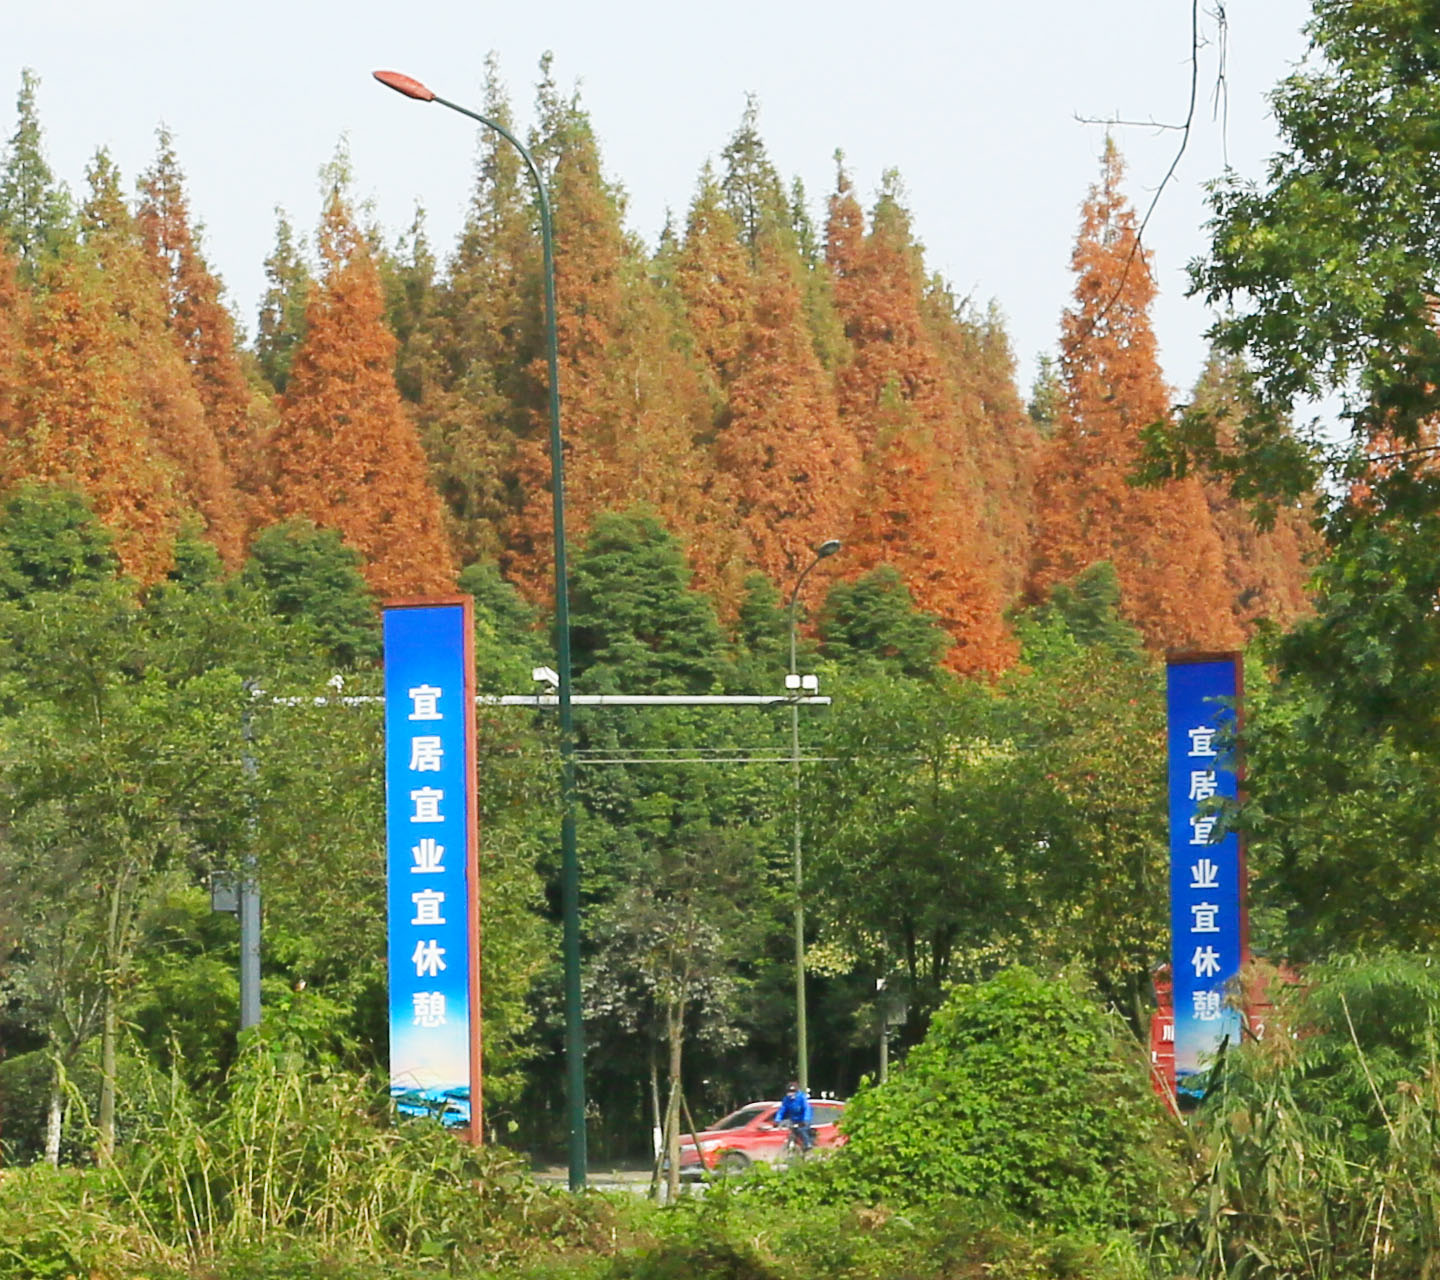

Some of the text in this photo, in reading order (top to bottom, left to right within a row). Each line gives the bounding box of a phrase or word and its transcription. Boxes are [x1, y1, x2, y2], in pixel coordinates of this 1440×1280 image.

[407, 683, 448, 1028] 宜居宜业宜休憩
[1187, 725, 1222, 1021] 宜居宜业宜休憩
